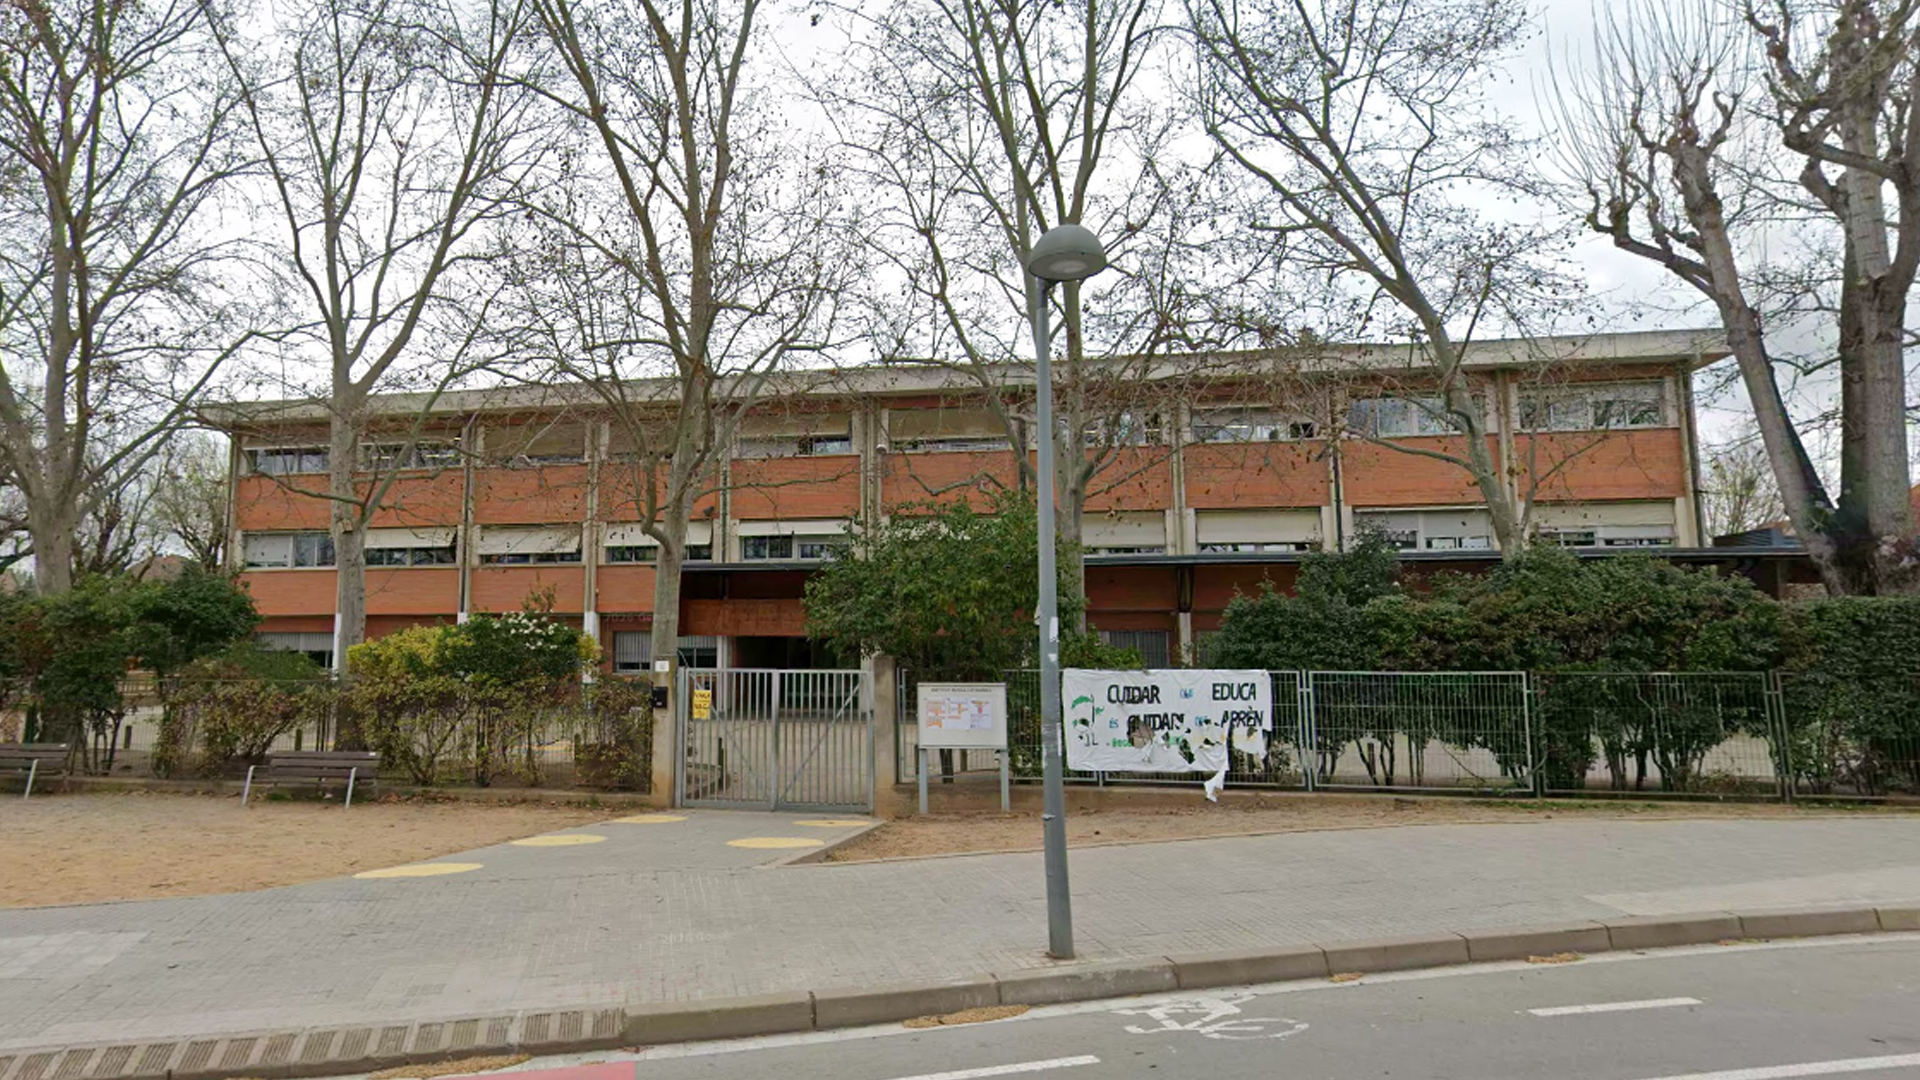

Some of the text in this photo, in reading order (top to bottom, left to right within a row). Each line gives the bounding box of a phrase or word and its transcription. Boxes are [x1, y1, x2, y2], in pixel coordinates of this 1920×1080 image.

[1107, 684, 1161, 704] CUIDAR
[1212, 683, 1256, 701] EDUCA
[1220, 705, 1264, 728] APRÈN
